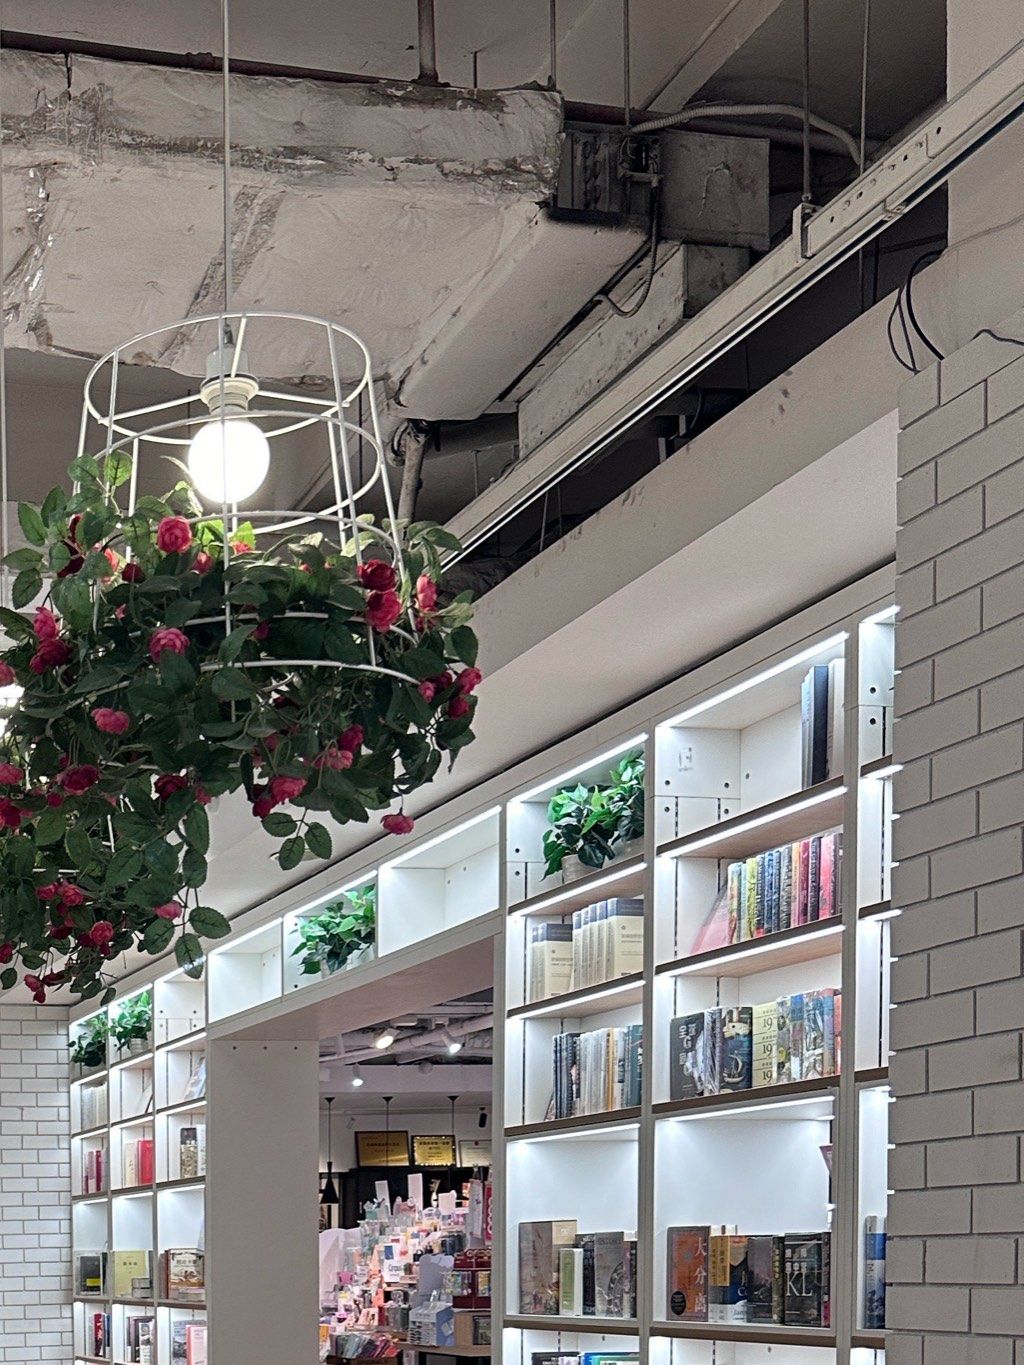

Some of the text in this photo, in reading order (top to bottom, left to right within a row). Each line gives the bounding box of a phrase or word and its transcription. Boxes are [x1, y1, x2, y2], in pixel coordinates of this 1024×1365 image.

[693, 1237, 708, 1314] 大分离
[785, 1272, 813, 1297] KL
